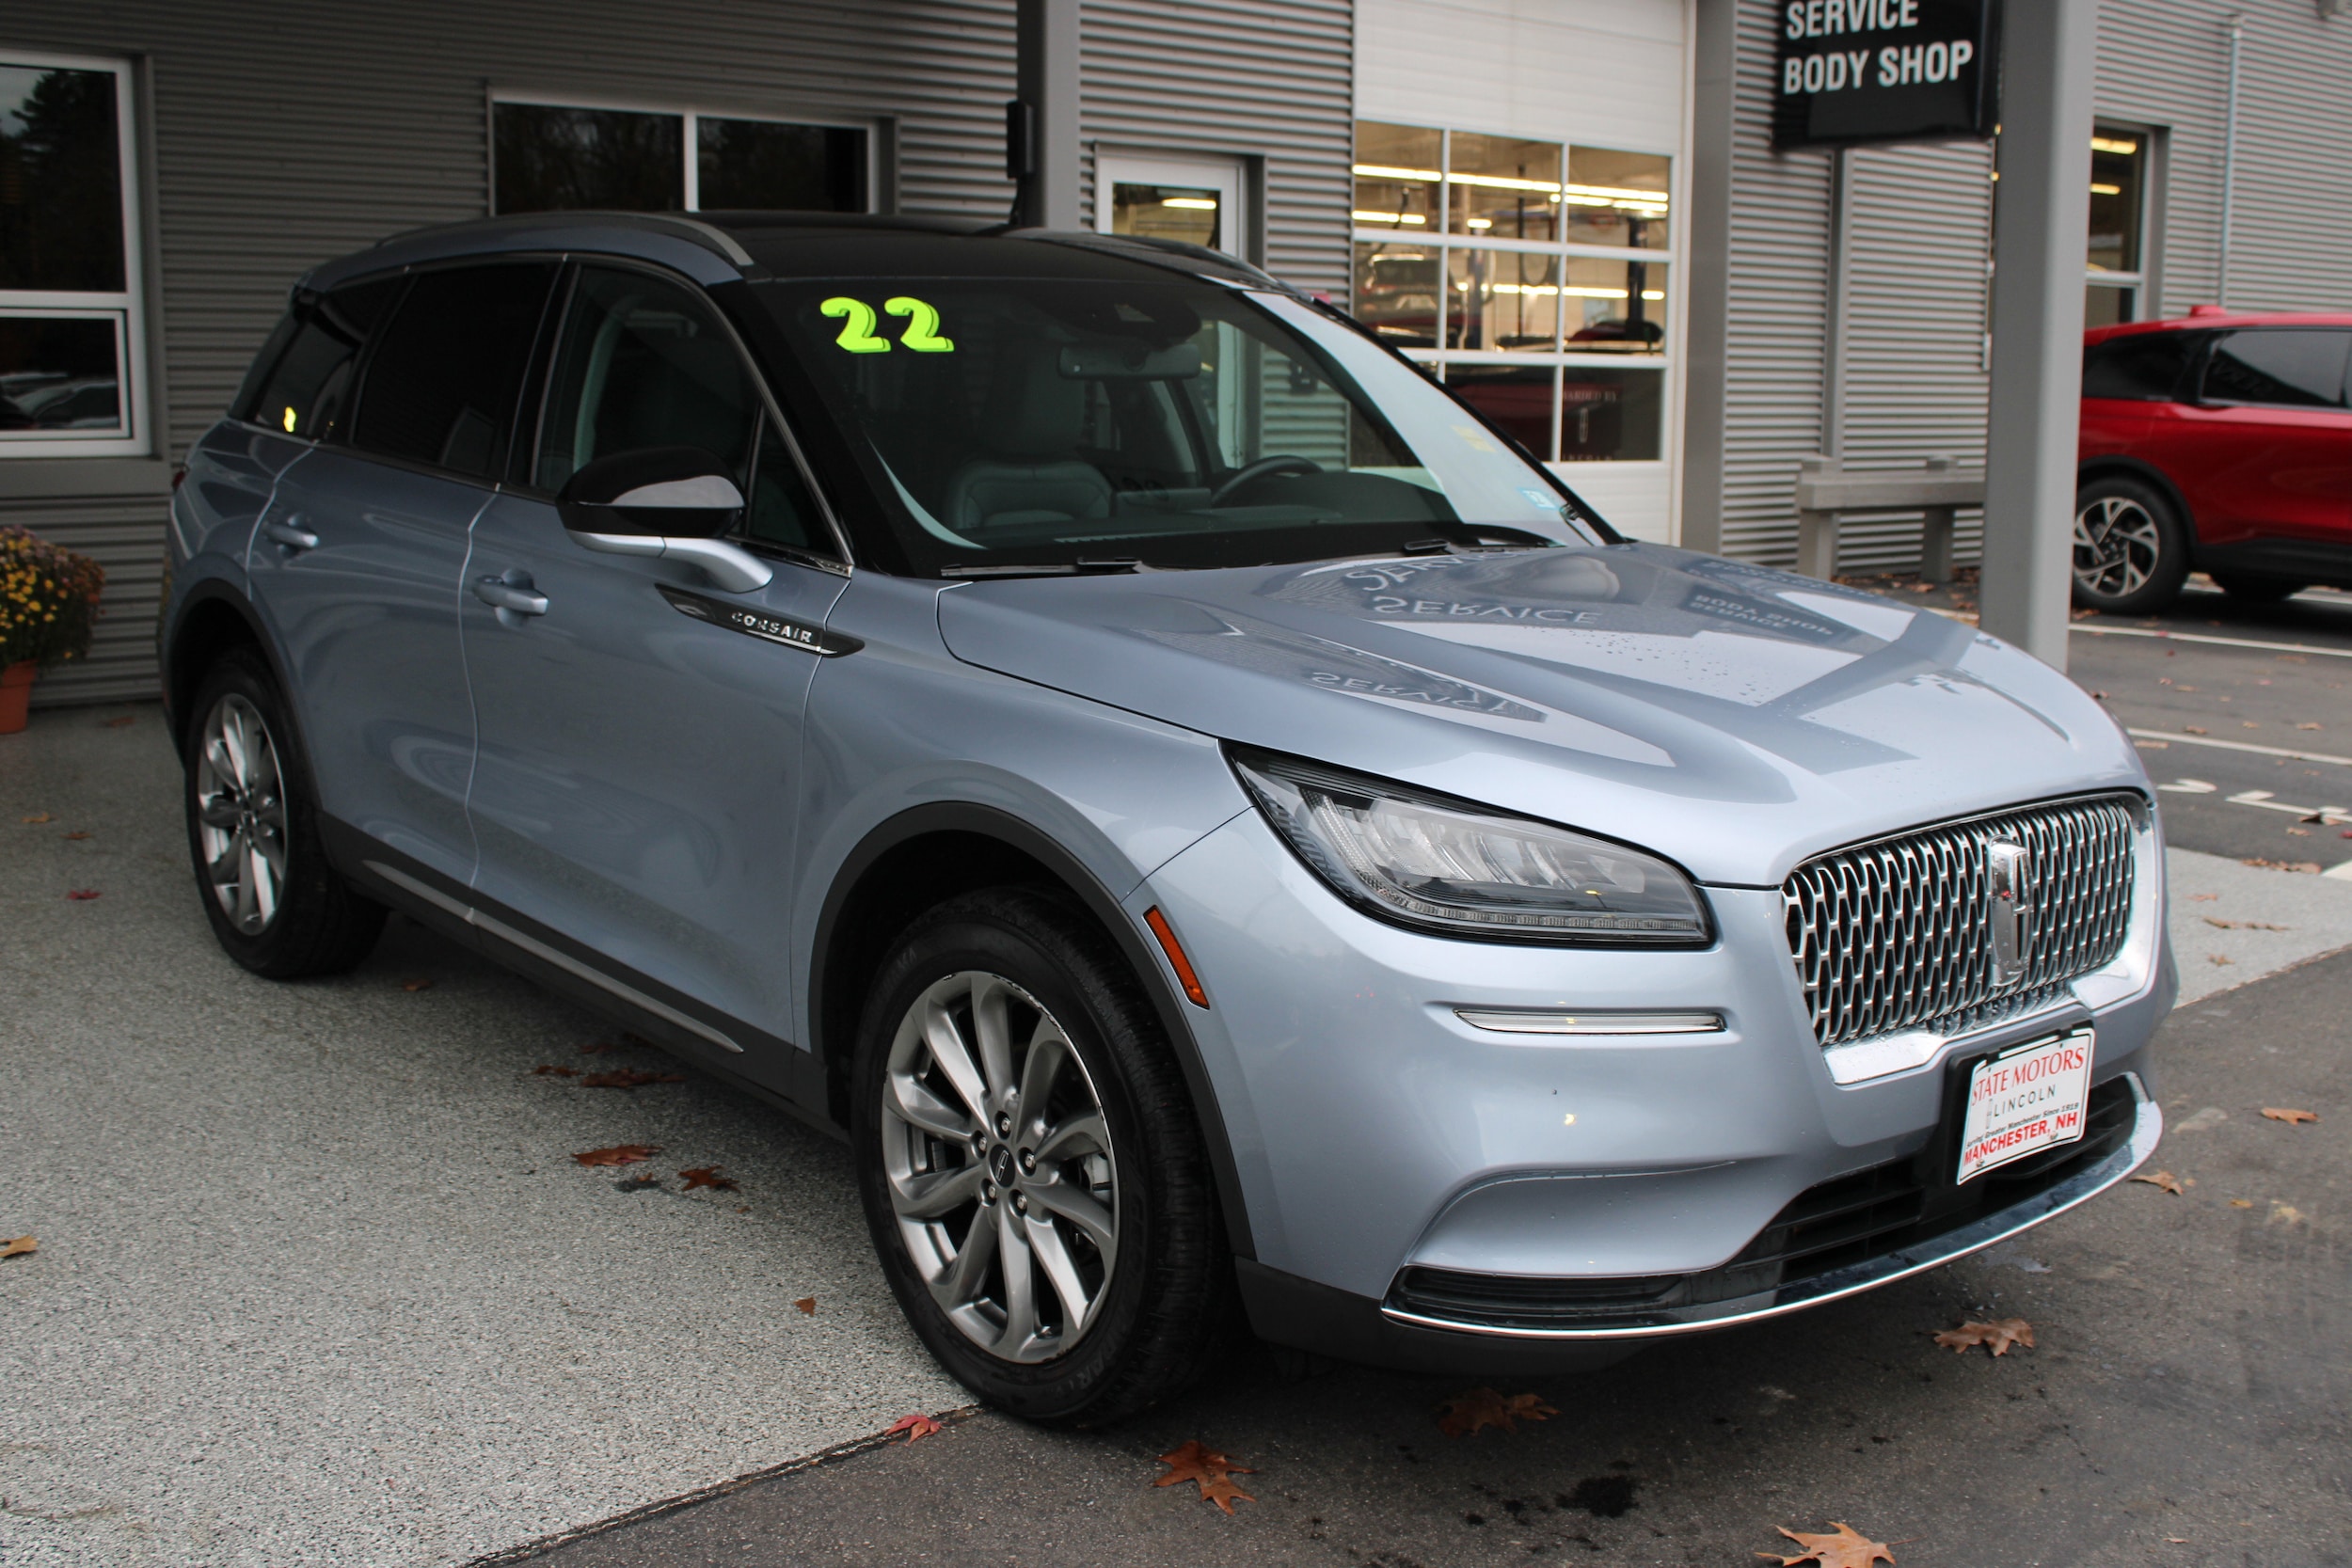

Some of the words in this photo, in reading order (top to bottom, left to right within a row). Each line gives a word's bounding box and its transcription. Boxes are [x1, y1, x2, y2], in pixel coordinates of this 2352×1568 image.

[1786, 0, 1918, 40] SERVICE
[1784, 50, 1869, 94] BODY
[1878, 40, 1973, 87] SHOP
[820, 296, 955, 353] 22
[731, 611, 813, 643] CORSAIR
[1971, 1069, 2009, 1106] STATE
[2011, 1047, 2085, 1088] MOTORS
[1994, 1085, 2056, 1117] LINCOLN
[2008, 1114, 2041, 1129] Manchester
[2042, 1108, 2059, 1117] Since
[1964, 1119, 2050, 1165] MANCHESTER,
[2056, 1112, 2077, 1130] NH
